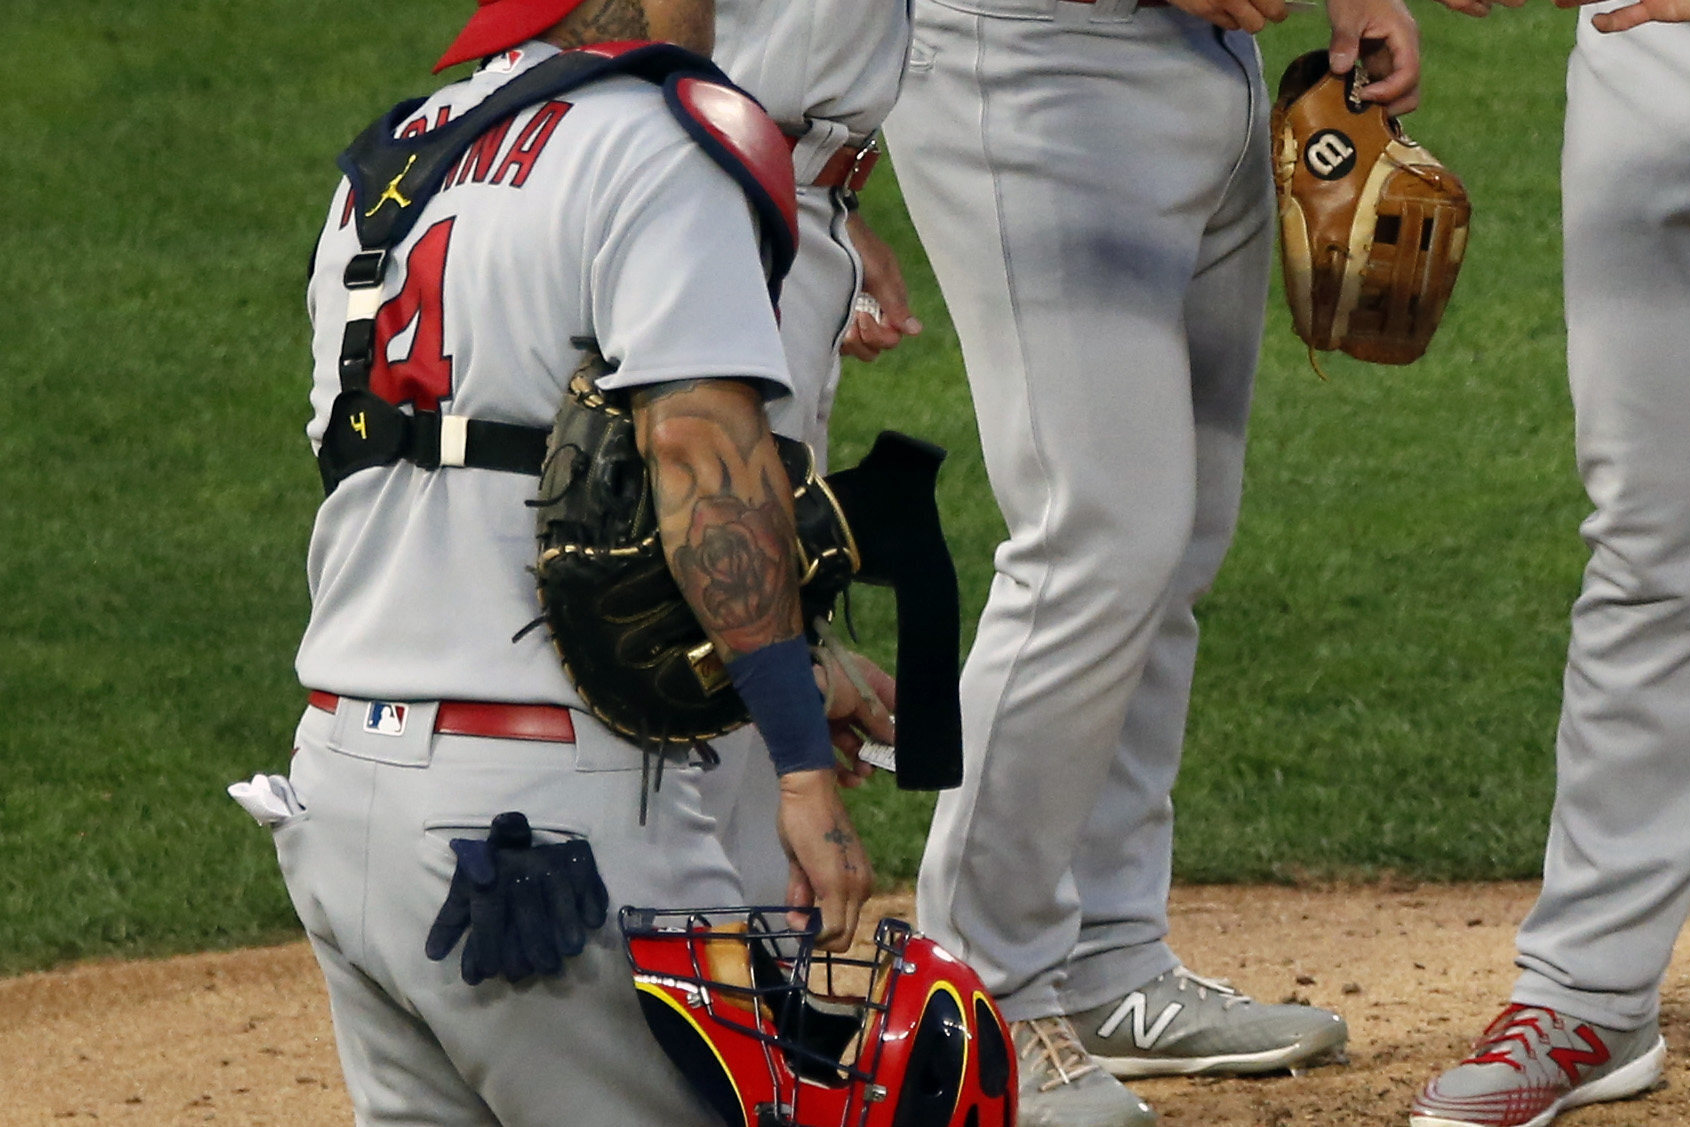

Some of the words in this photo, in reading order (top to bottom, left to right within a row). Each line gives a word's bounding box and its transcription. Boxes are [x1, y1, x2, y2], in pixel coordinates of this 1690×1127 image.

[368, 215, 456, 412] 4
[350, 411, 369, 439] 4
[1097, 991, 1184, 1052] N
